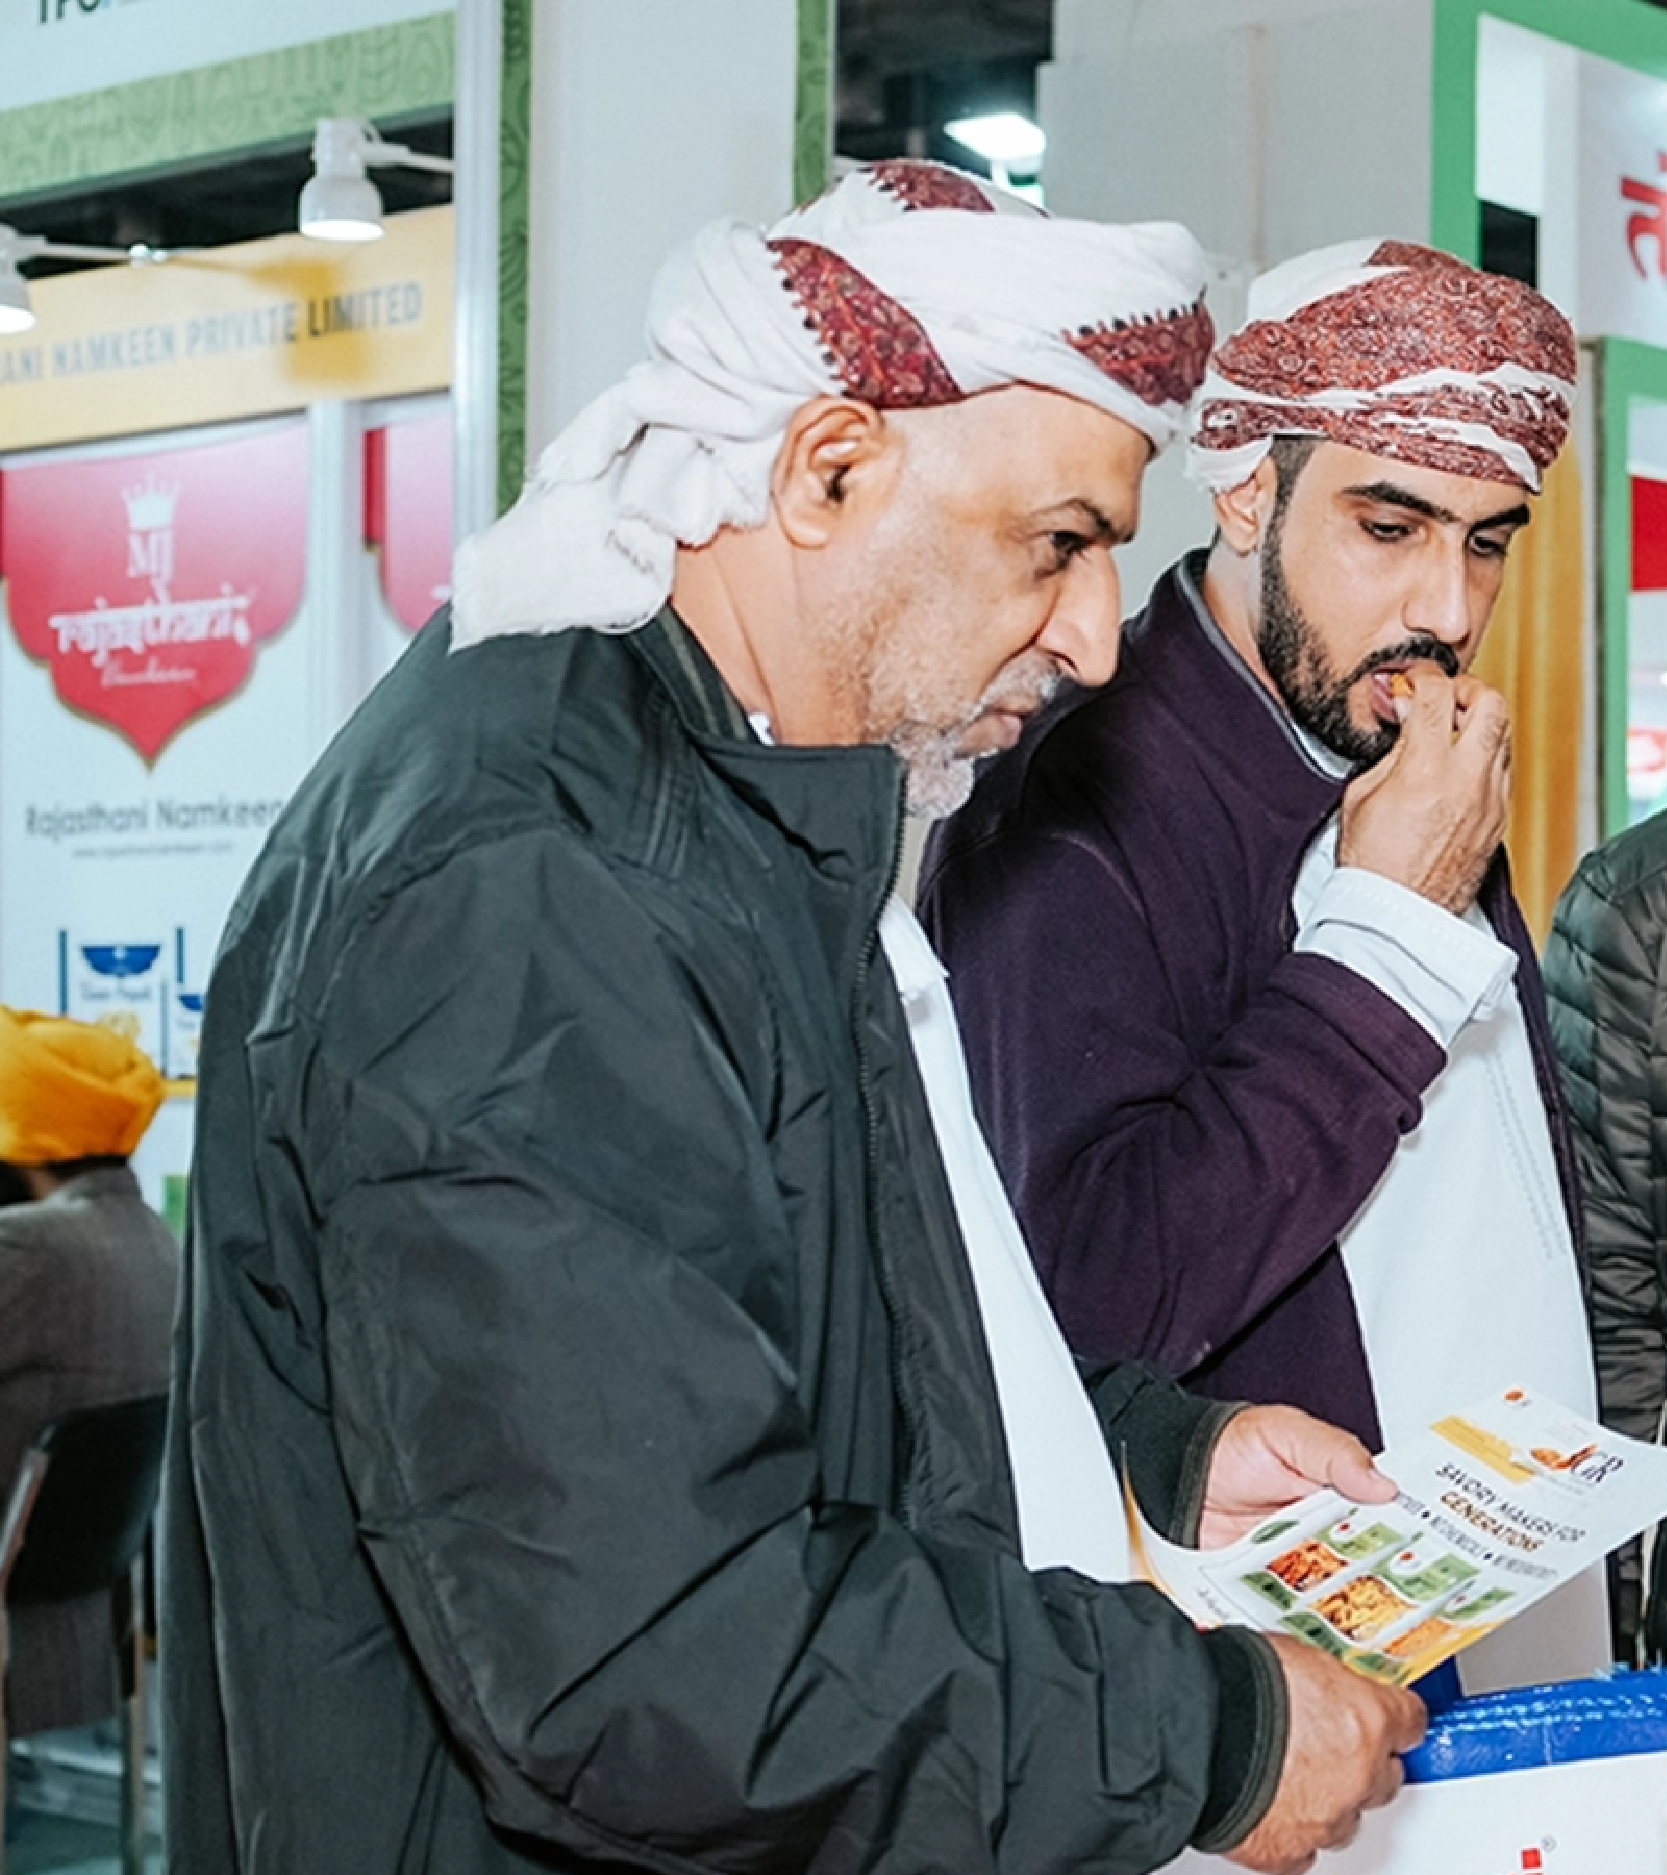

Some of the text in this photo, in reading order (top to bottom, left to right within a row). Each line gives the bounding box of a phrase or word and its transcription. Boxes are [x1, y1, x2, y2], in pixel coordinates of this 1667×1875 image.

[54, 326, 175, 375] NAMKEEN
[186, 303, 297, 355] PRIVATE
[308, 283, 421, 338] LIMITED
[26, 798, 148, 843] Rajasthani
[1436, 1463, 1496, 1504] SAVORY
[1441, 1491, 1544, 1552] GENERATIONS
